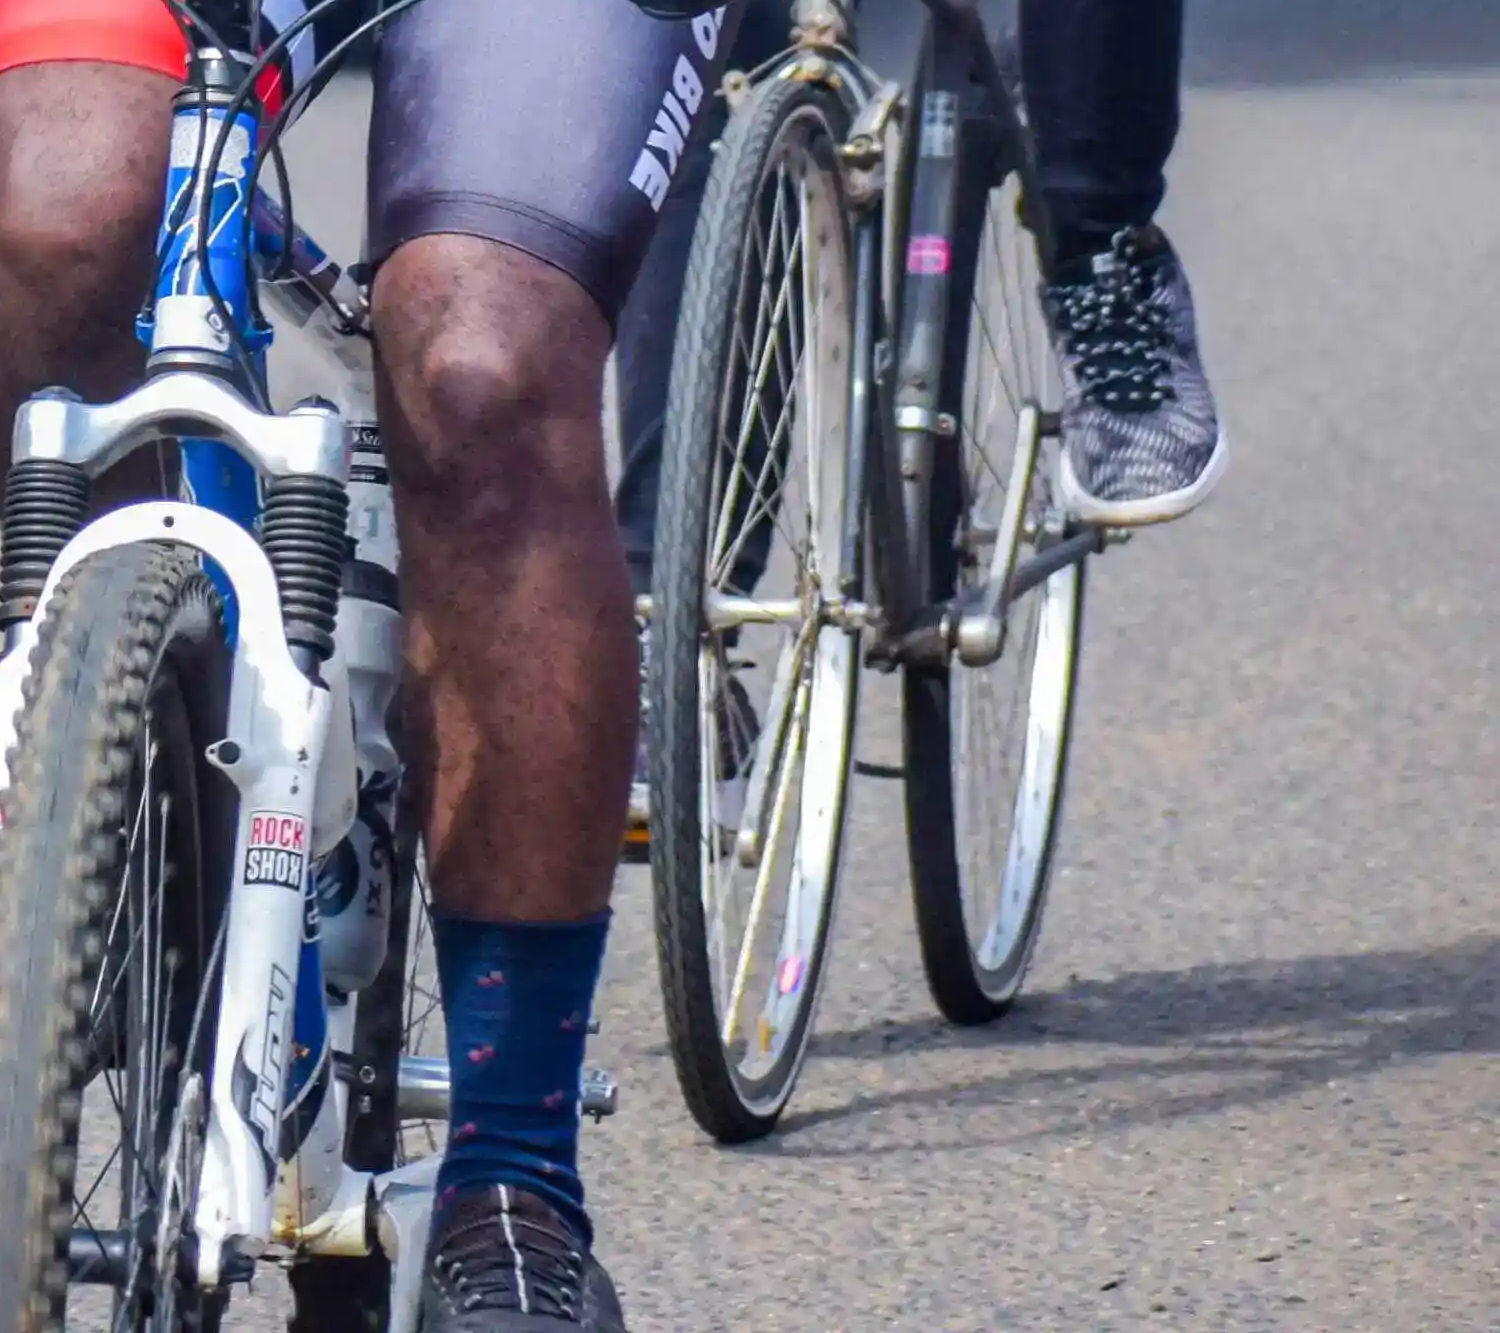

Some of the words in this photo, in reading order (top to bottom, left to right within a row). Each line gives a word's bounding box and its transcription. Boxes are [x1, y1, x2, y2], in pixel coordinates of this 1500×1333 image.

[628, 53, 704, 213] BIKE
[251, 816, 305, 847] ROCK
[246, 849, 302, 885] SHOX
